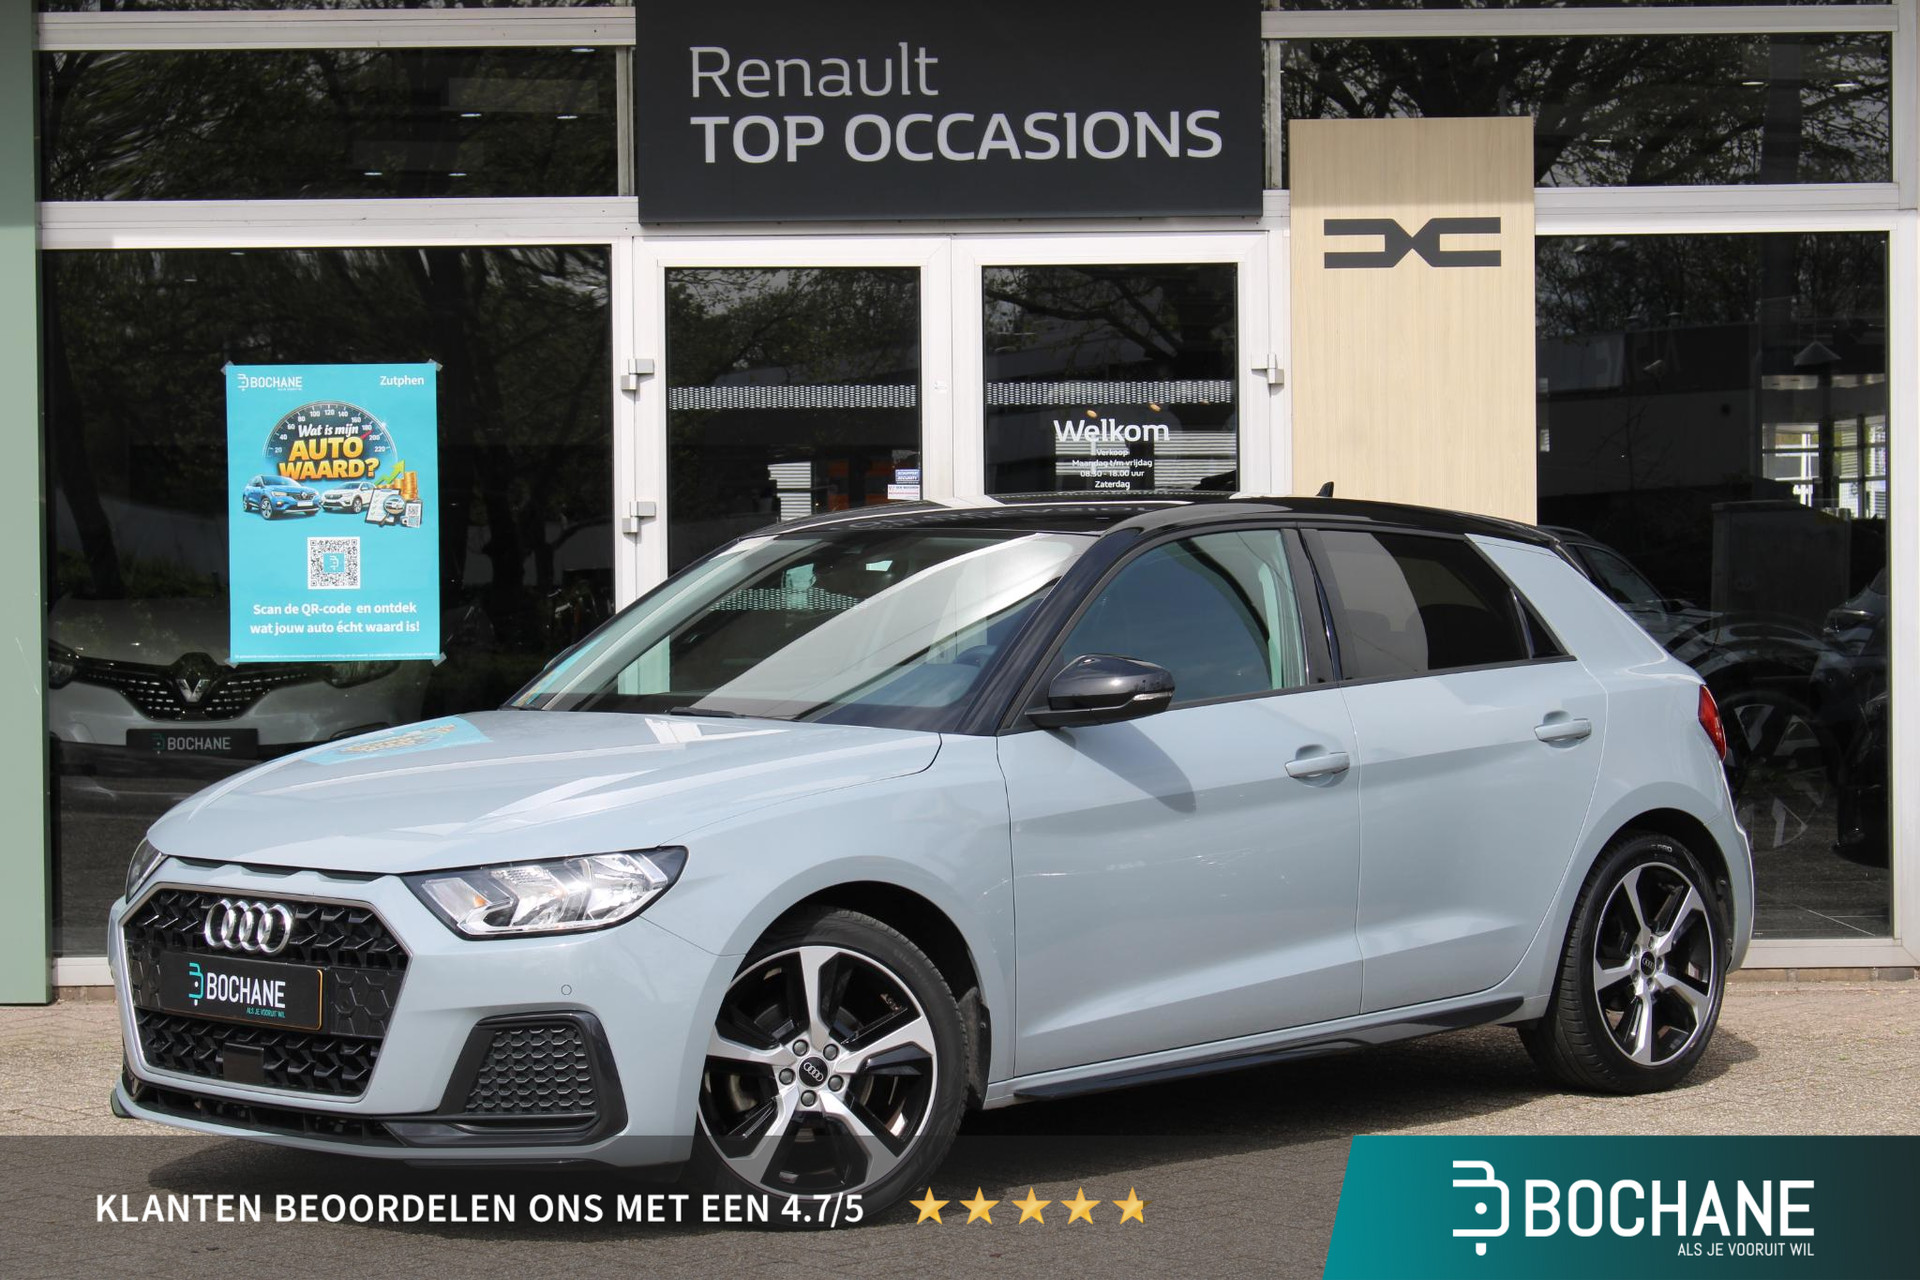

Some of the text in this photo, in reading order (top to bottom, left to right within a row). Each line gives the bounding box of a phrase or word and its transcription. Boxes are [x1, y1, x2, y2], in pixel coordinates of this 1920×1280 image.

[689, 42, 939, 98] Renault
[690, 110, 1223, 163] TOP OCCASIONS
[250, 376, 302, 388] BOCHANE
[380, 375, 425, 388] Zutphen
[298, 423, 359, 437] Wat is mijn
[1053, 418, 1170, 442] Welkom
[288, 437, 364, 461] AUTO
[1096, 448, 1129, 457] Verkoop
[279, 457, 380, 480] WAARD?
[1072, 459, 1153, 468] Maandag t/m vrijdag
[1109, 469, 1130, 477] 18.00
[1095, 480, 1131, 490] Zaterdag
[253, 602, 417, 617] Scan de QR-code en ontdek
[250, 620, 420, 636] wat jouw auto écht waard is!
[167, 736, 232, 751] BOCHANE
[206, 972, 286, 1009] BOCHANE
